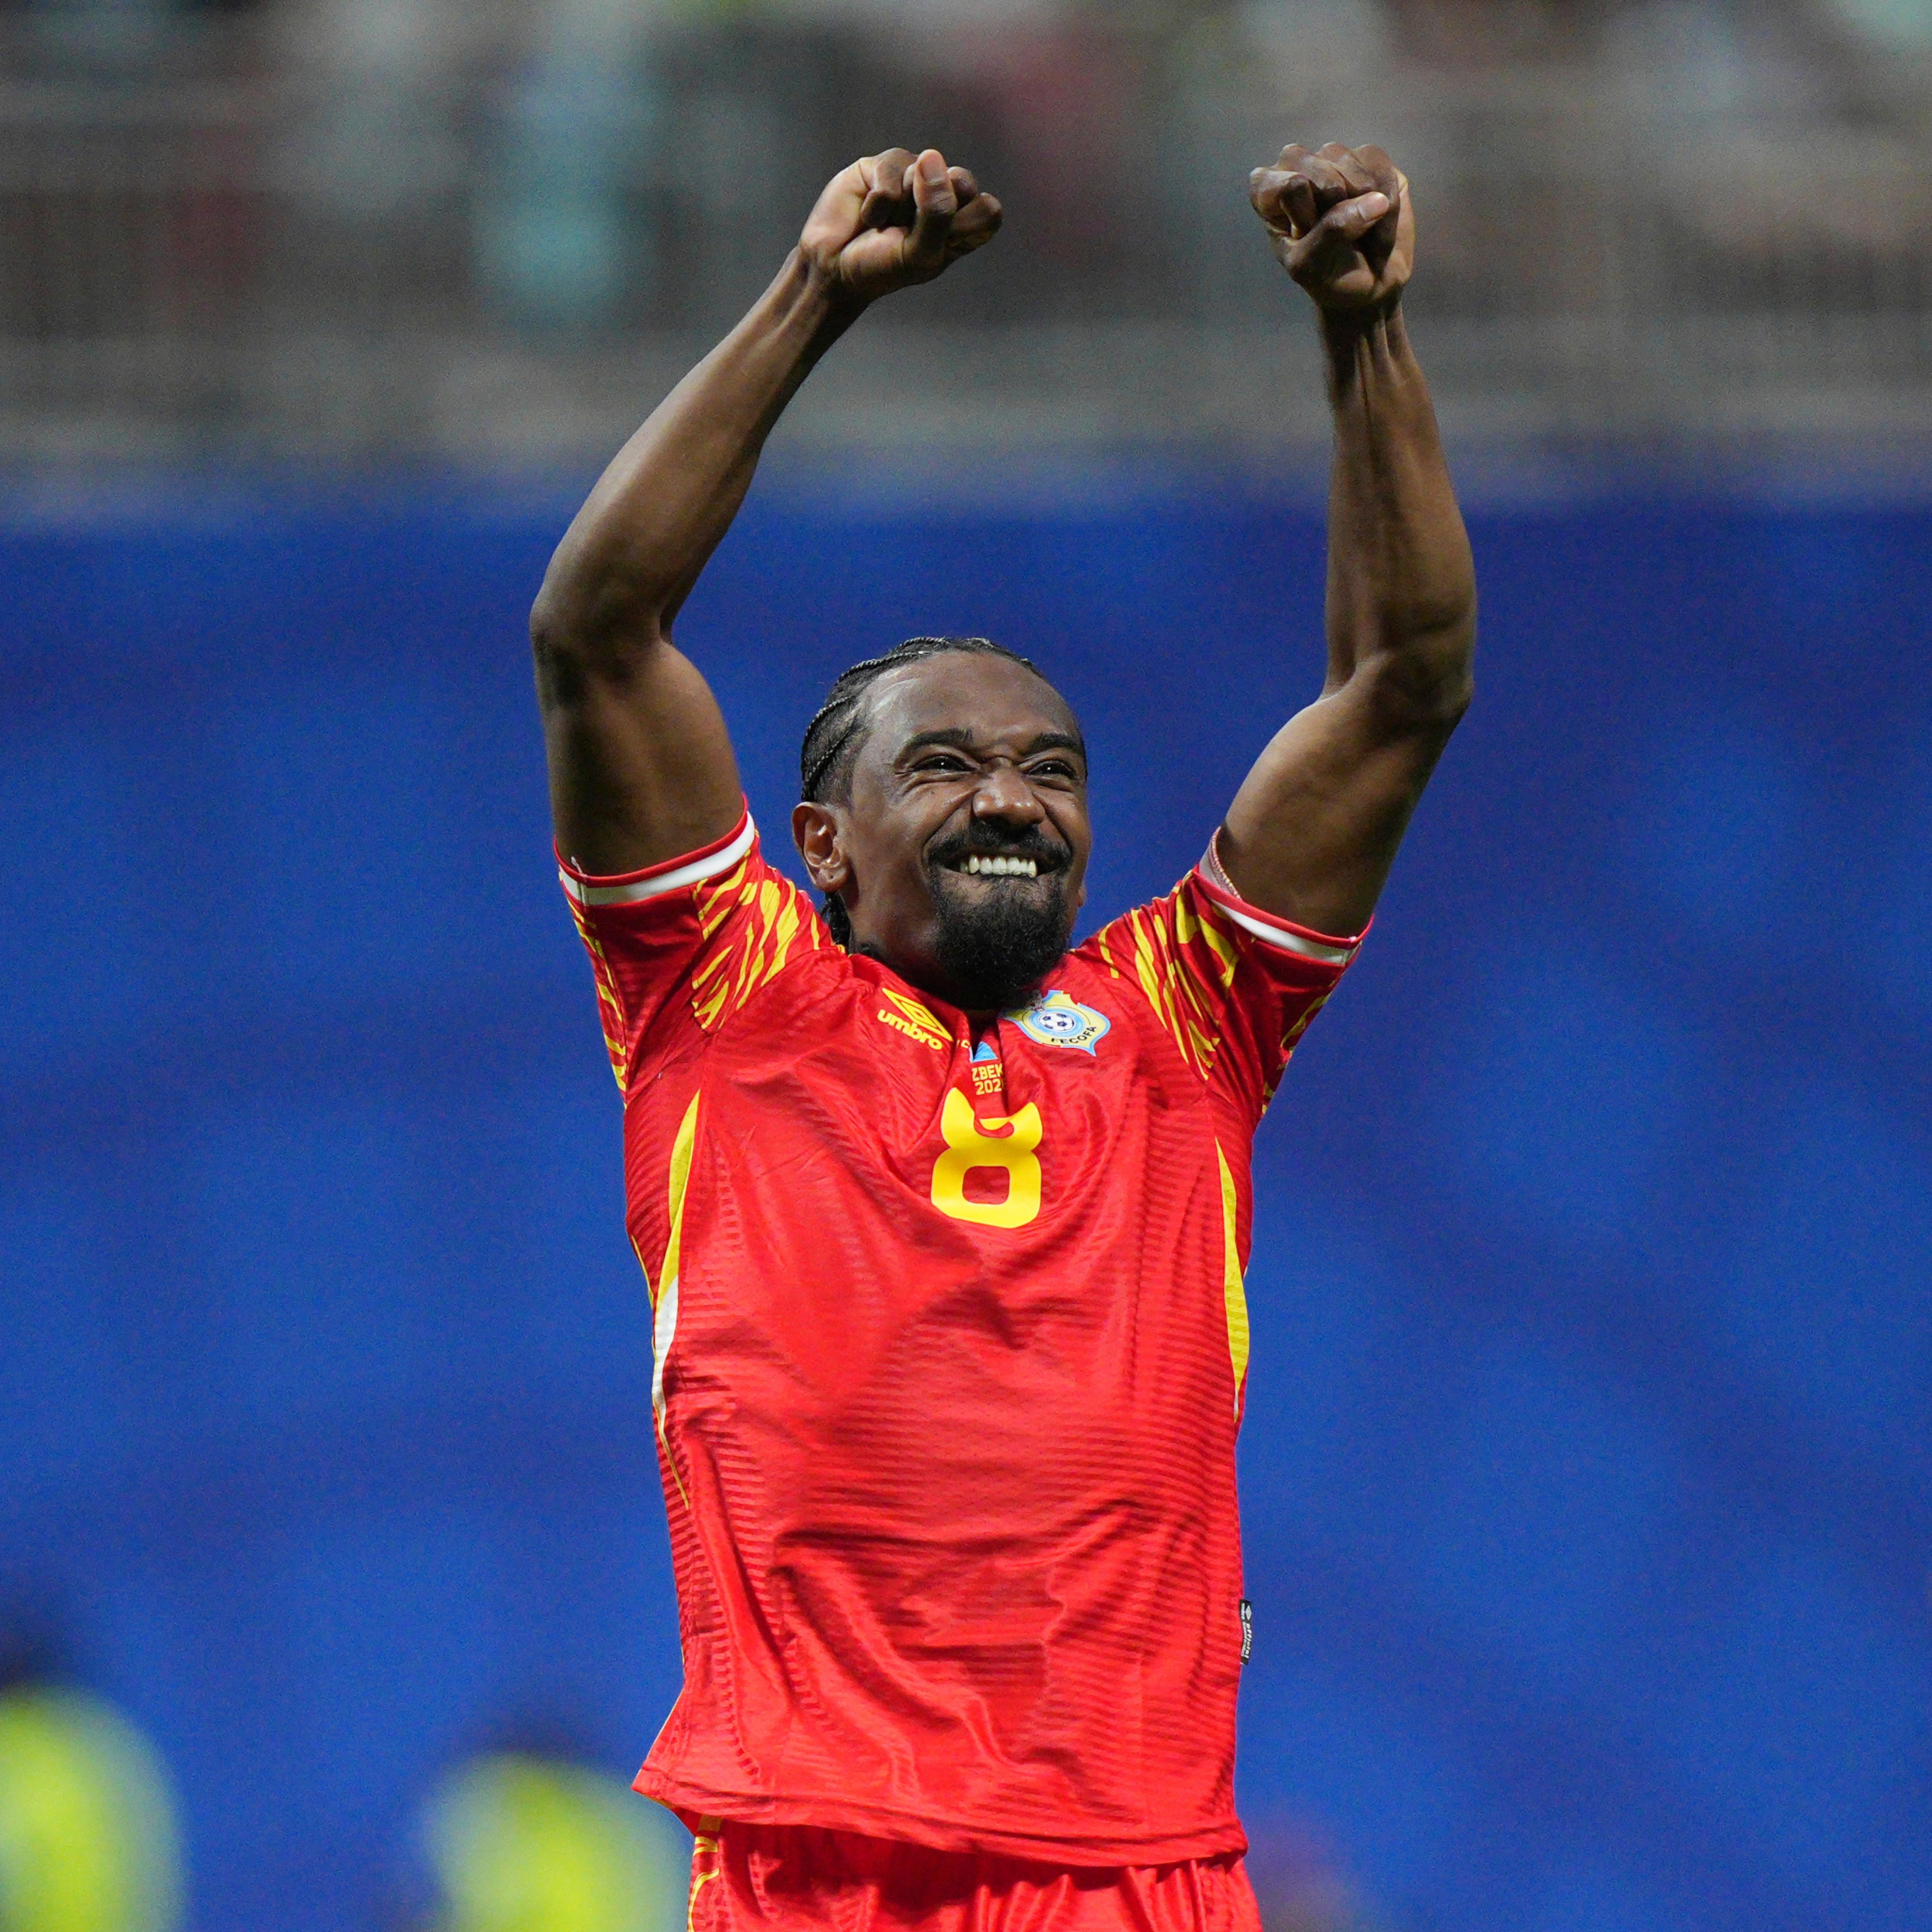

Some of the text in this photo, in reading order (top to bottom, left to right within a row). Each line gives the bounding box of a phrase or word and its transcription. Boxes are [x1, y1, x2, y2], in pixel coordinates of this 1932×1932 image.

[877, 1009, 942, 1050] umbro
[1051, 1026, 1097, 1044] FECOFA
[975, 1078, 1004, 1095] 202
[931, 1087, 1043, 1228] 8
